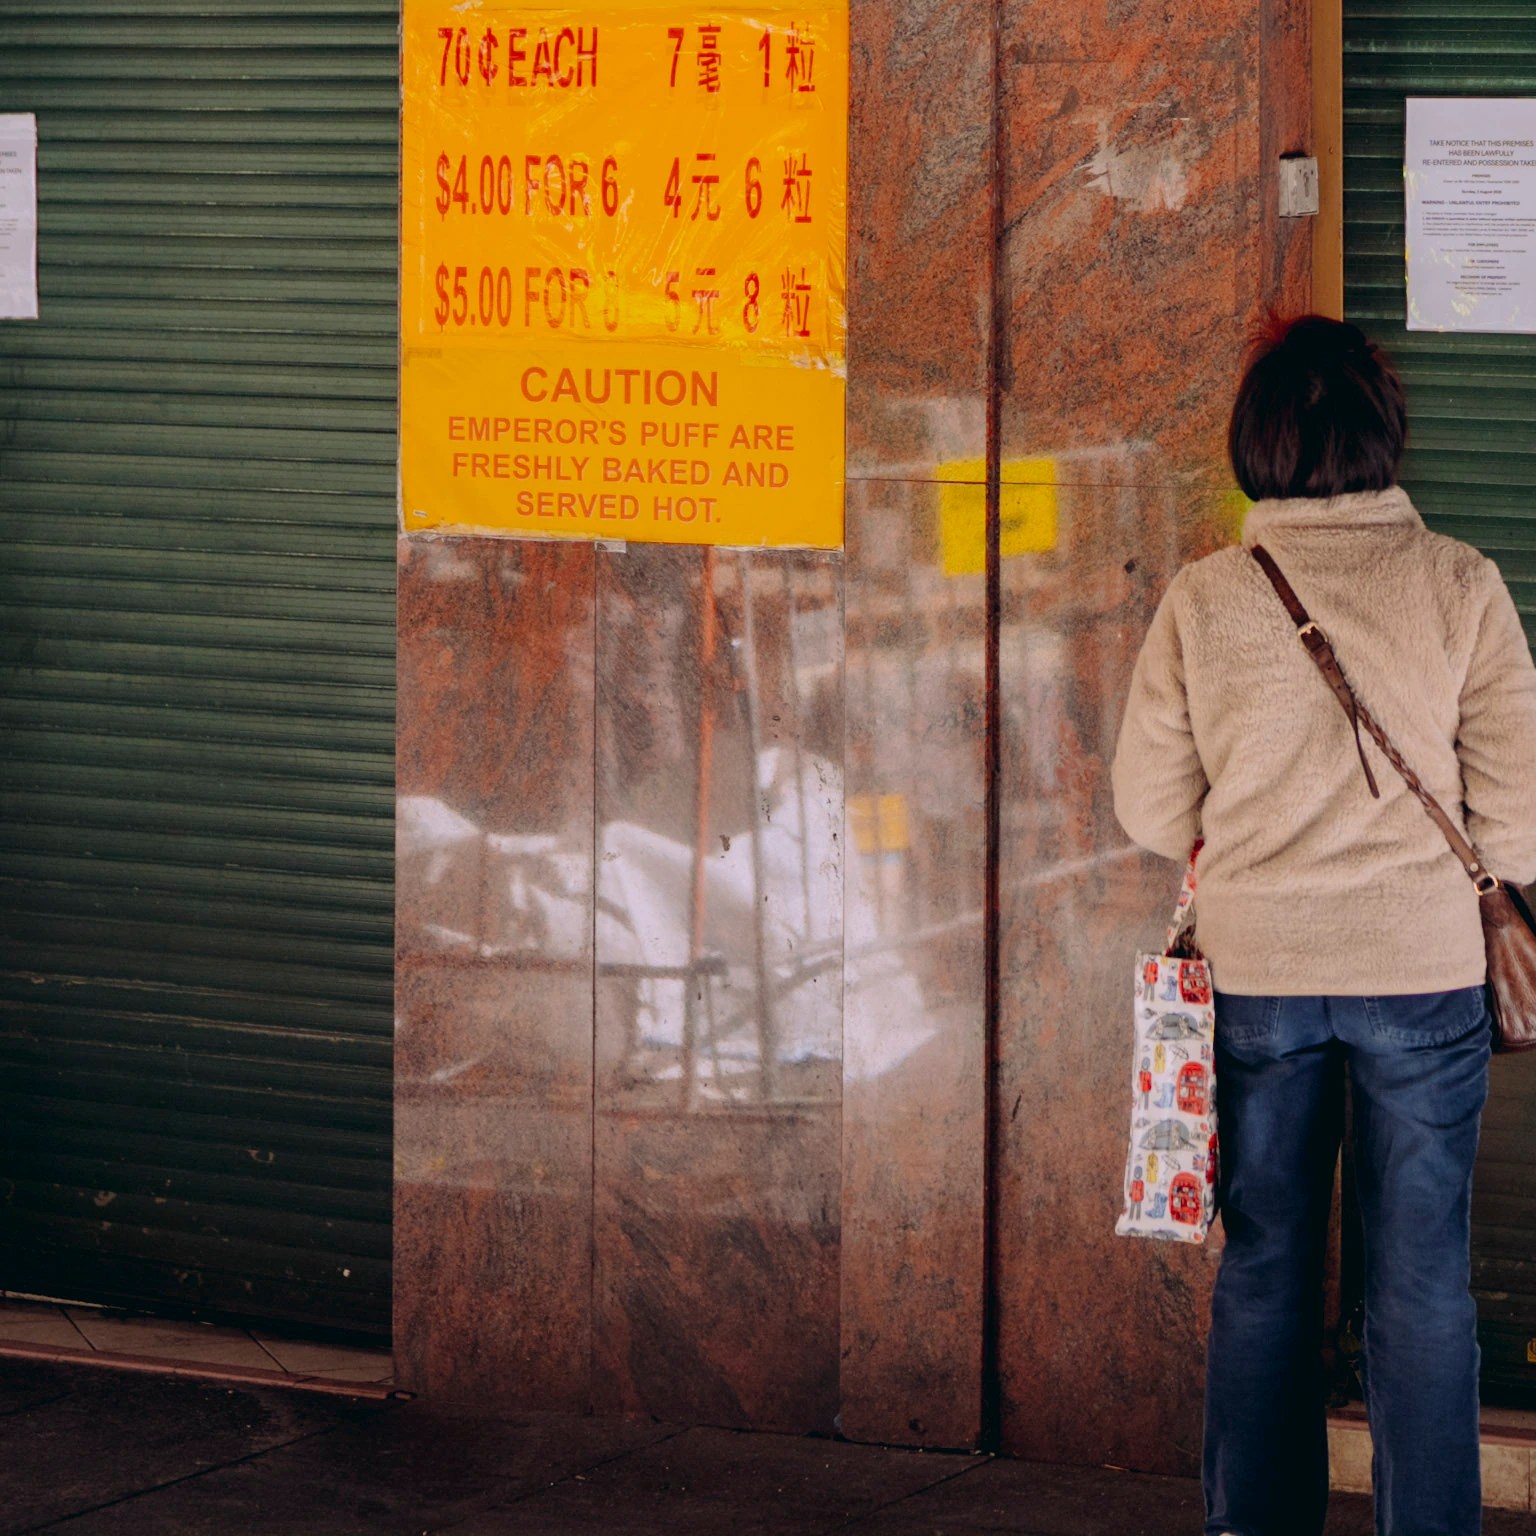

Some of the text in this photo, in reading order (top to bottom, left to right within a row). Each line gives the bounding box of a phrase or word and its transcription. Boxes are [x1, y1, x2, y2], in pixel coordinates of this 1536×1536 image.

[508, 27, 599, 88] EACH
[1429, 139, 1445, 147] TAKE
[1446, 139, 1469, 147] NOTICE
[435, 151, 619, 221] $4.00 FOR 6
[434, 264, 513, 331] $5.00
[524, 267, 591, 330] FOR
[520, 366, 718, 407] CAUTION
[448, 416, 795, 452] EMPEROR'S PUFF ARE
[452, 452, 790, 488] FRESHLY BAKED AND
[516, 490, 721, 524] SERVED HOT.
